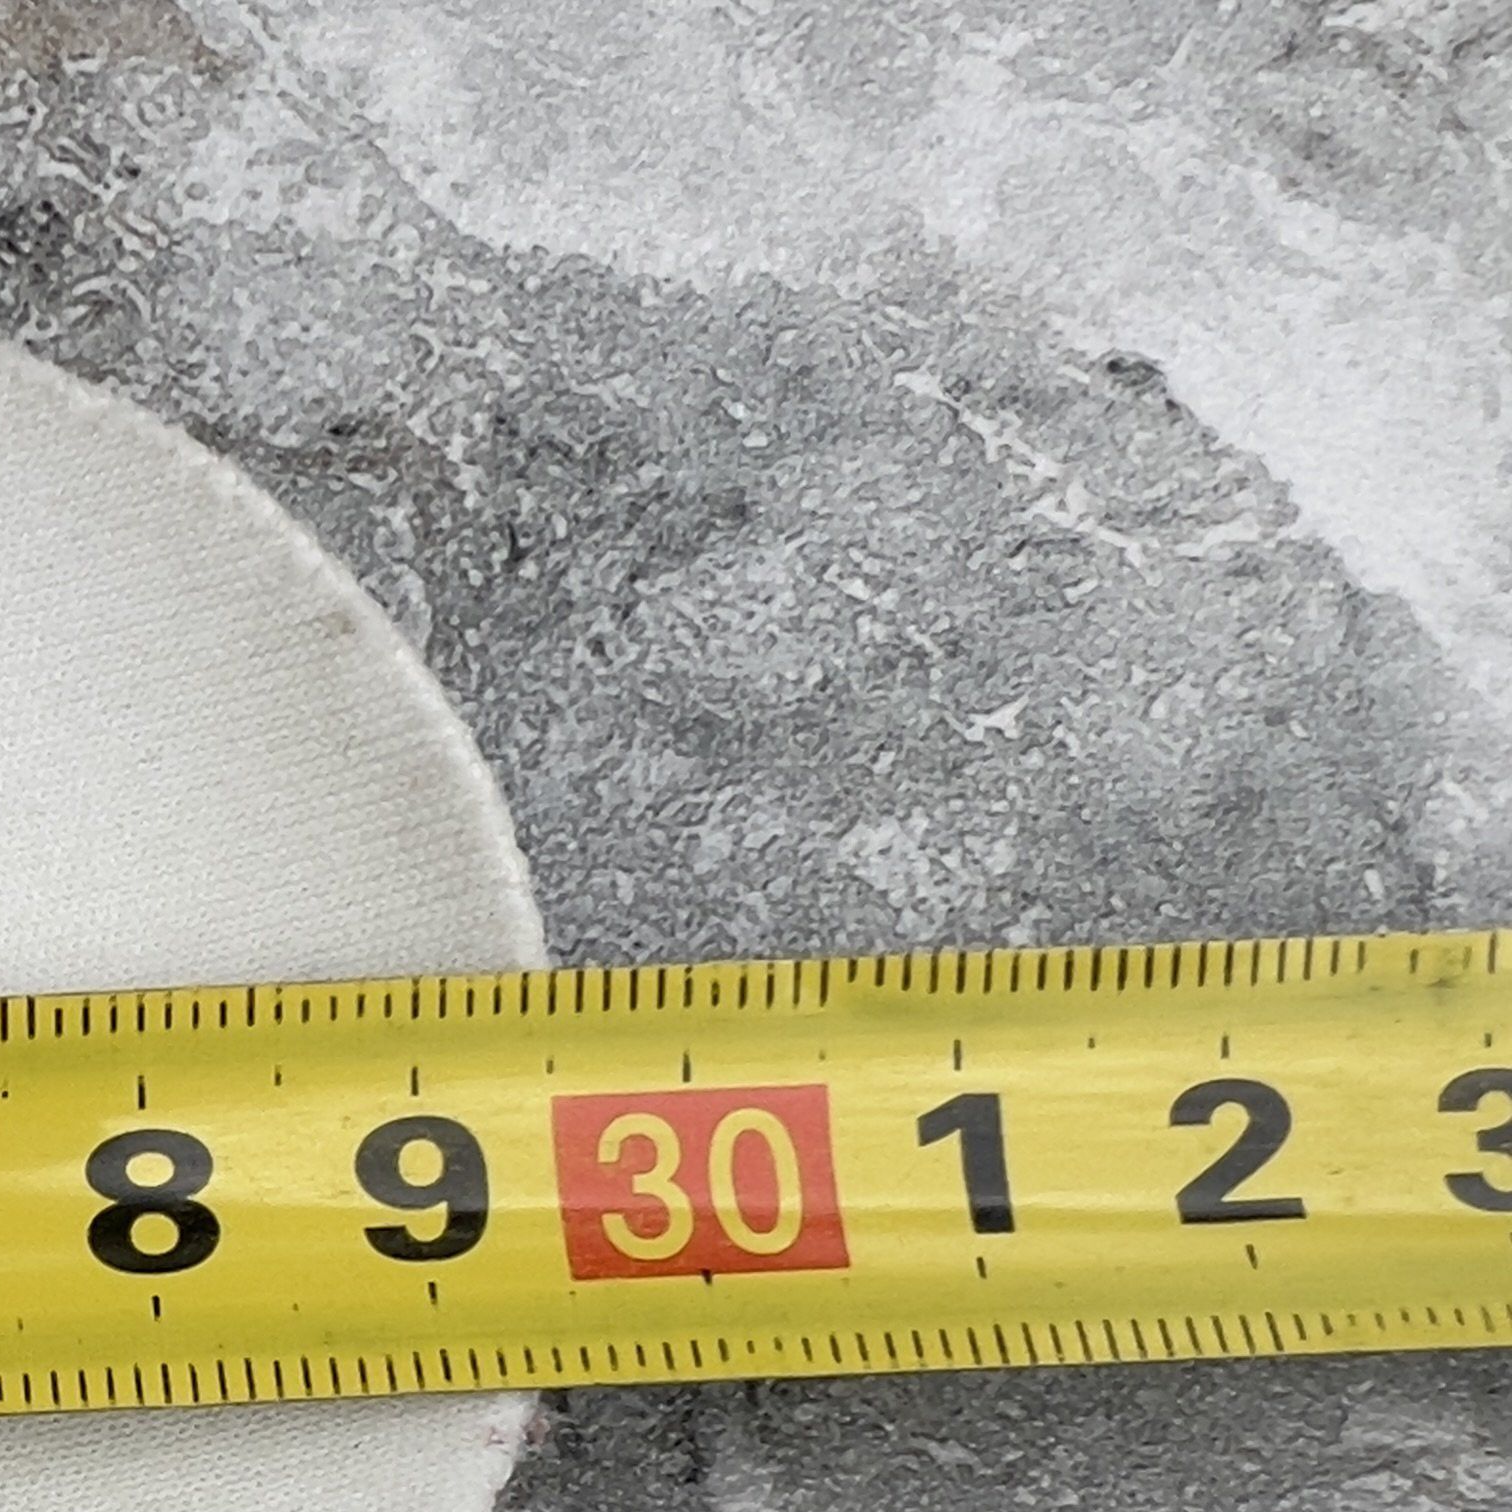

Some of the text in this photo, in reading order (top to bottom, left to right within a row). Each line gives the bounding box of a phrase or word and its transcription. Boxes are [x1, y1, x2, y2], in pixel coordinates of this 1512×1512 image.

[86, 1129, 221, 1275] 8
[354, 1116, 488, 1262] 9
[595, 1106, 804, 1262] 30
[916, 1092, 1015, 1235] 1
[1168, 1077, 1307, 1225] 2
